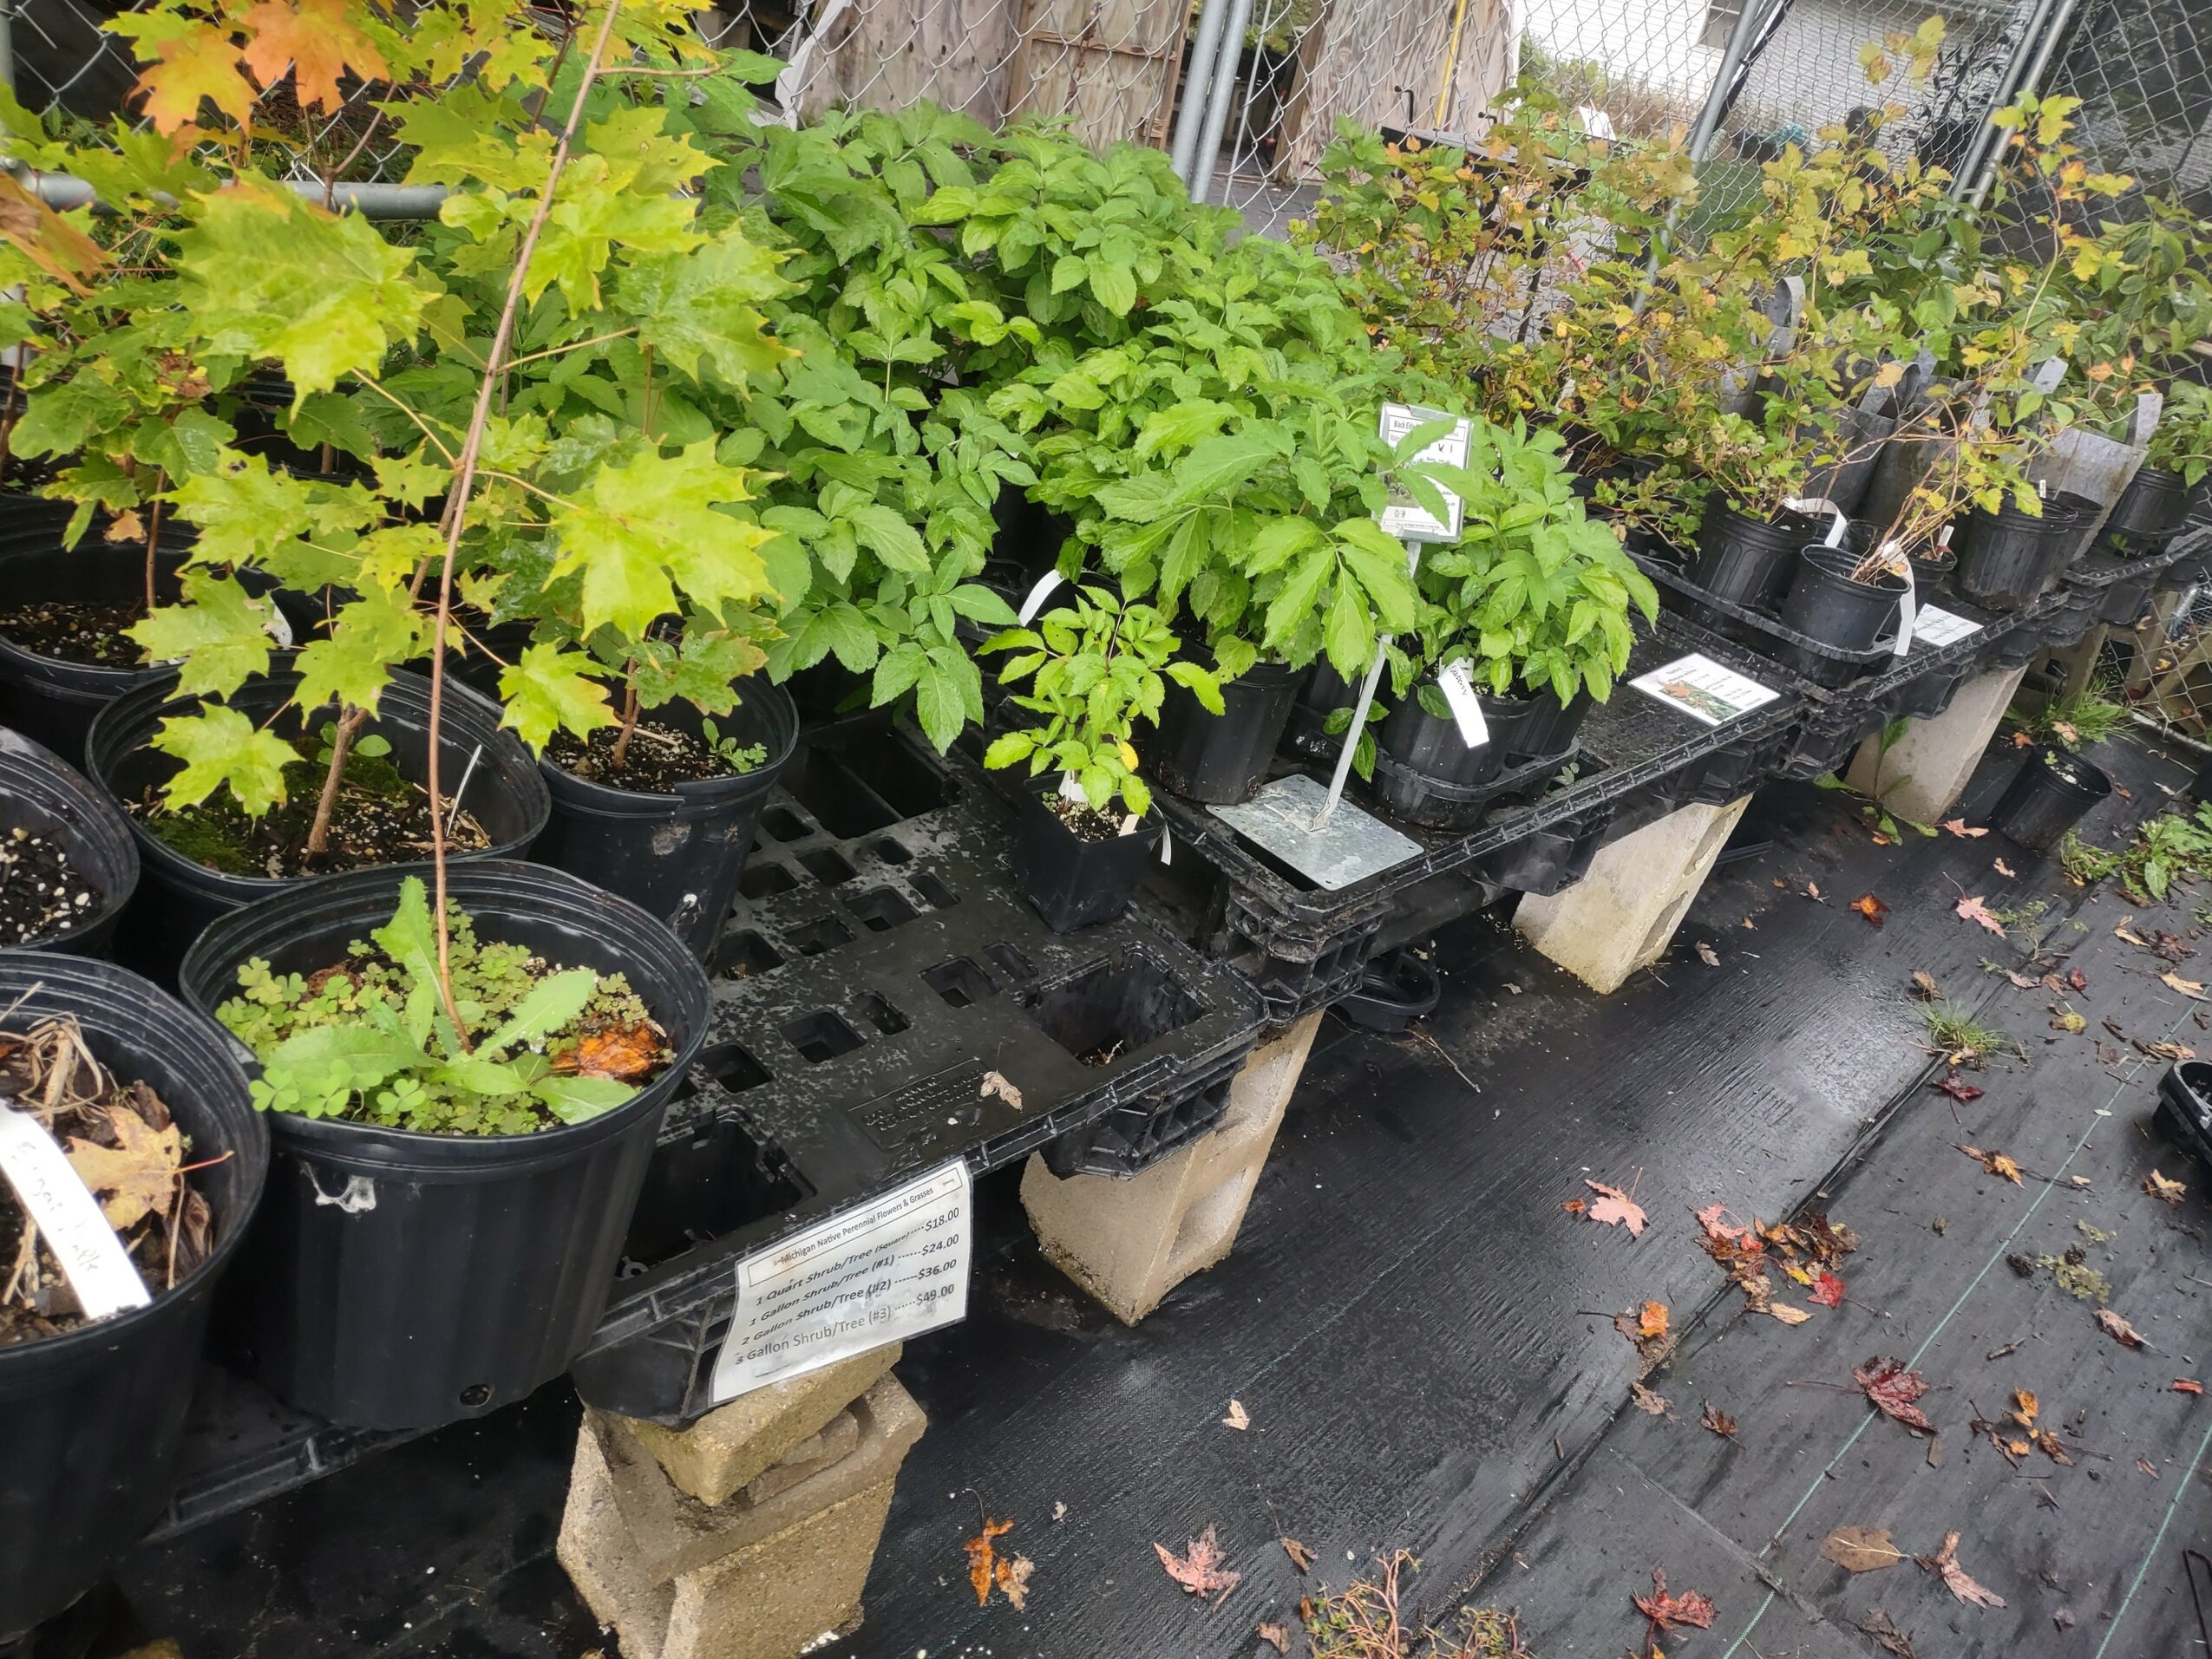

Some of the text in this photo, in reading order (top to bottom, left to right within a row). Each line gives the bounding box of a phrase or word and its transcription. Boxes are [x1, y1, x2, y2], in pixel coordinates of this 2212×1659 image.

[817, 1231, 841, 1248] Native
[842, 1214, 876, 1237] Perennial
[877, 1202, 903, 1220] Flowers
[903, 1199, 910, 1207] &
[910, 1186, 934, 1204] Grasses
[749, 1315, 756, 1327] 1
[761, 1298, 800, 1322] Gallon
[803, 1268, 869, 1303] Shrub/Tree
[871, 1254, 895, 1273] (#1)
[756, 1296, 763, 1306] 1
[766, 1279, 803, 1301] Quart
[806, 1249, 874, 1285] Shrub/Tree
[874, 1231, 910, 1253] (Square)
[741, 1336, 750, 1346] 2
[753, 1318, 793, 1342] Gallon
[796, 1290, 864, 1321] Shrub/Tree
[866, 1278, 892, 1300] (#2)
[747, 1340, 790, 1362] Gallon
[794, 1316, 865, 1347] Shrub/Tree
[867, 1304, 892, 1327] (#3)
